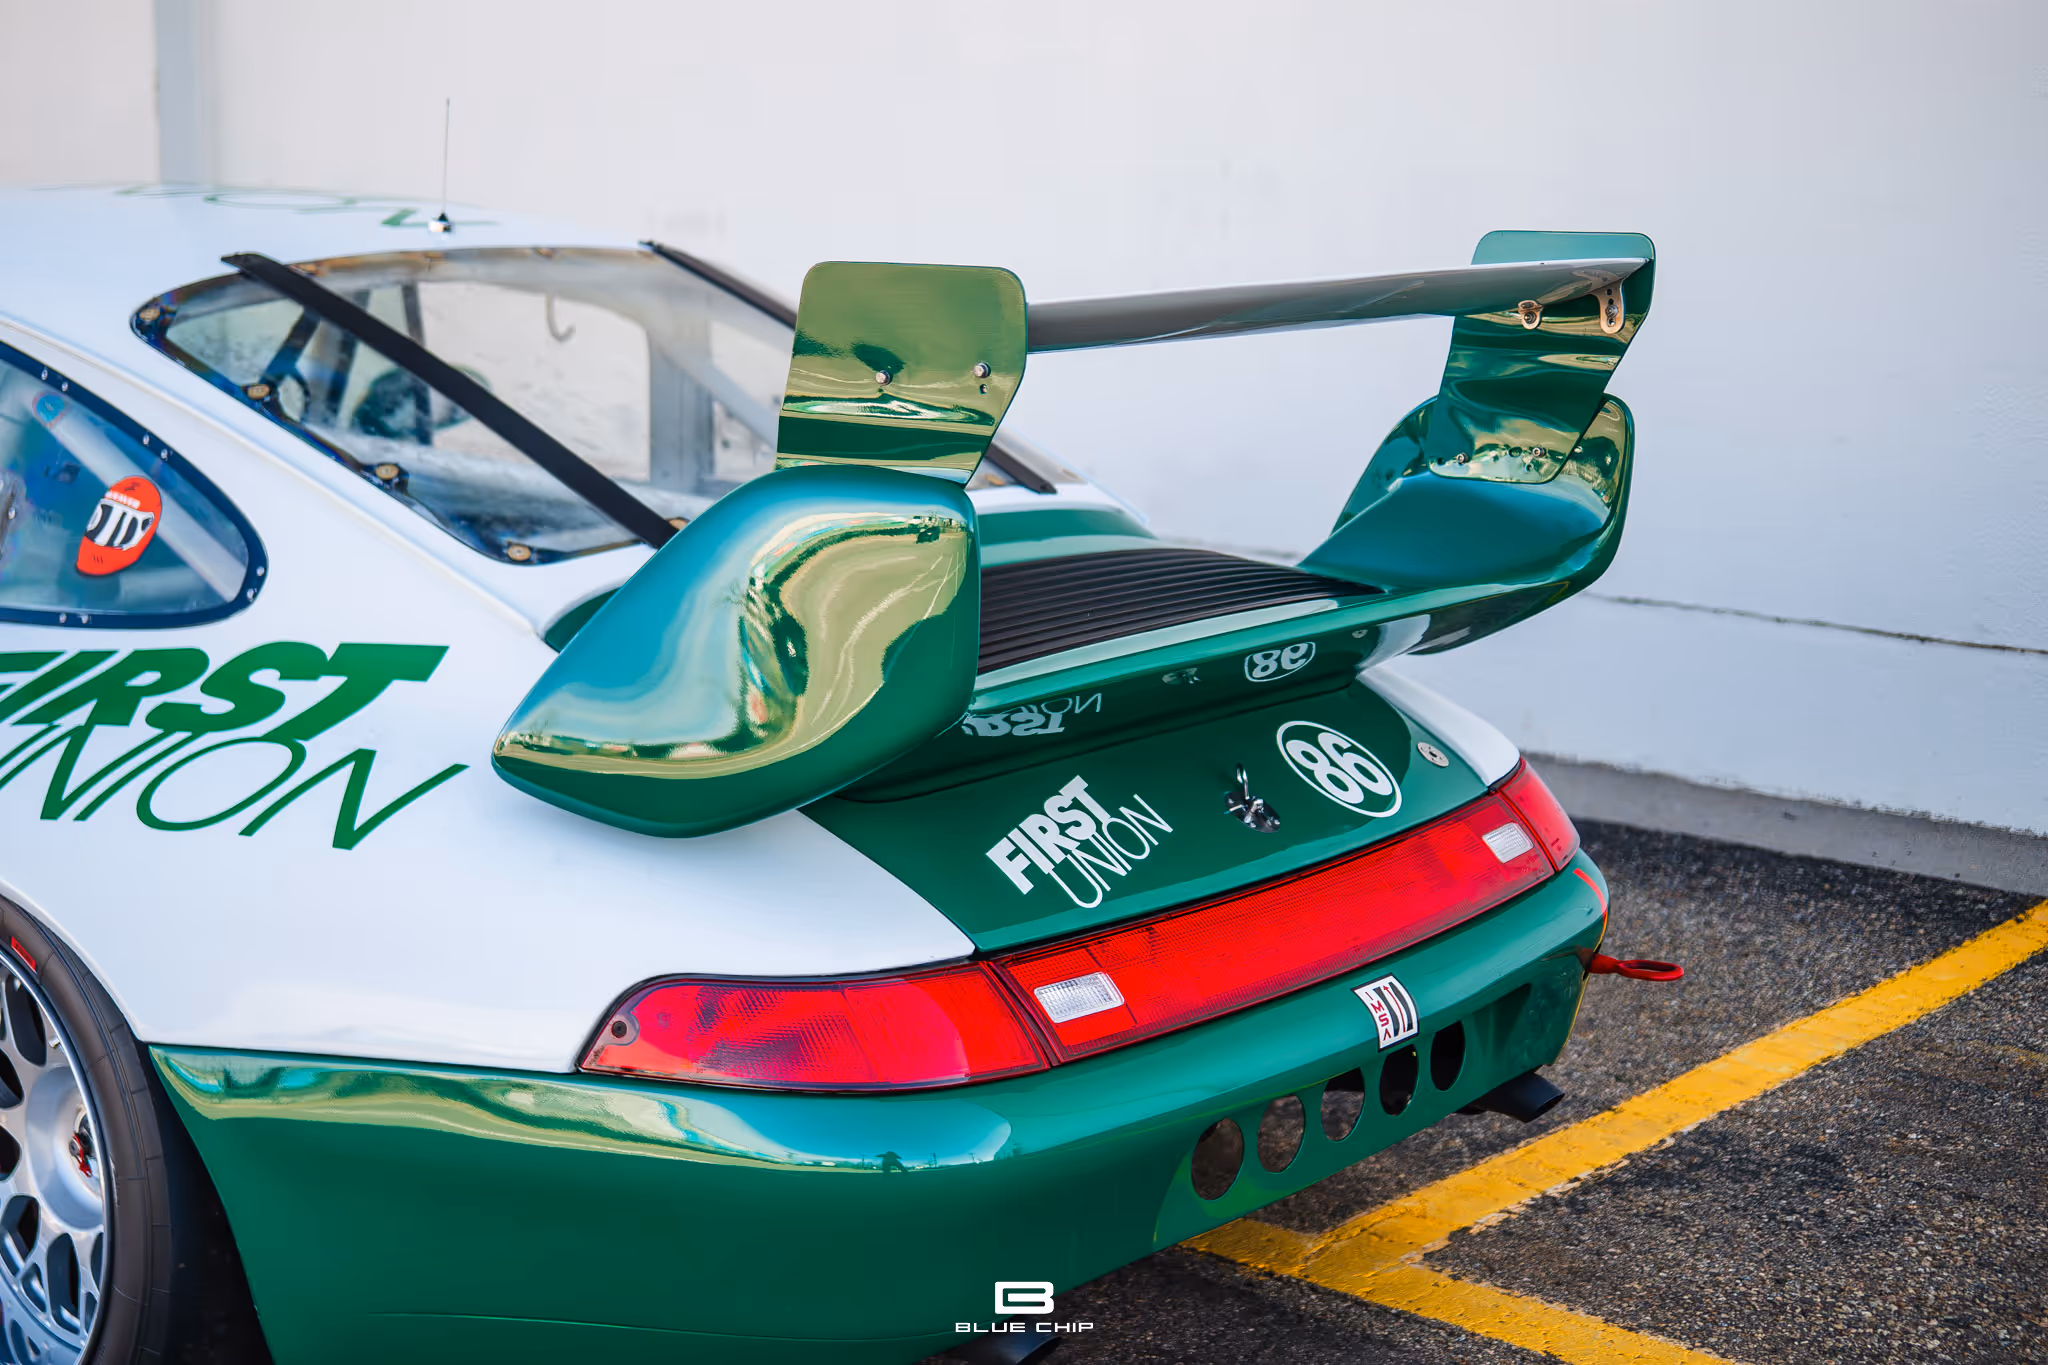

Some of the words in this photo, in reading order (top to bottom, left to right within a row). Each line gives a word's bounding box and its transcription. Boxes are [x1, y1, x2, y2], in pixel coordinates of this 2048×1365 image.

[0, 724, 470, 850] NION
[1285, 732, 1393, 804] 86
[986, 775, 1112, 895] FIRST
[1048, 794, 1173, 908] UNION
[1364, 991, 1392, 1041] IMSA
